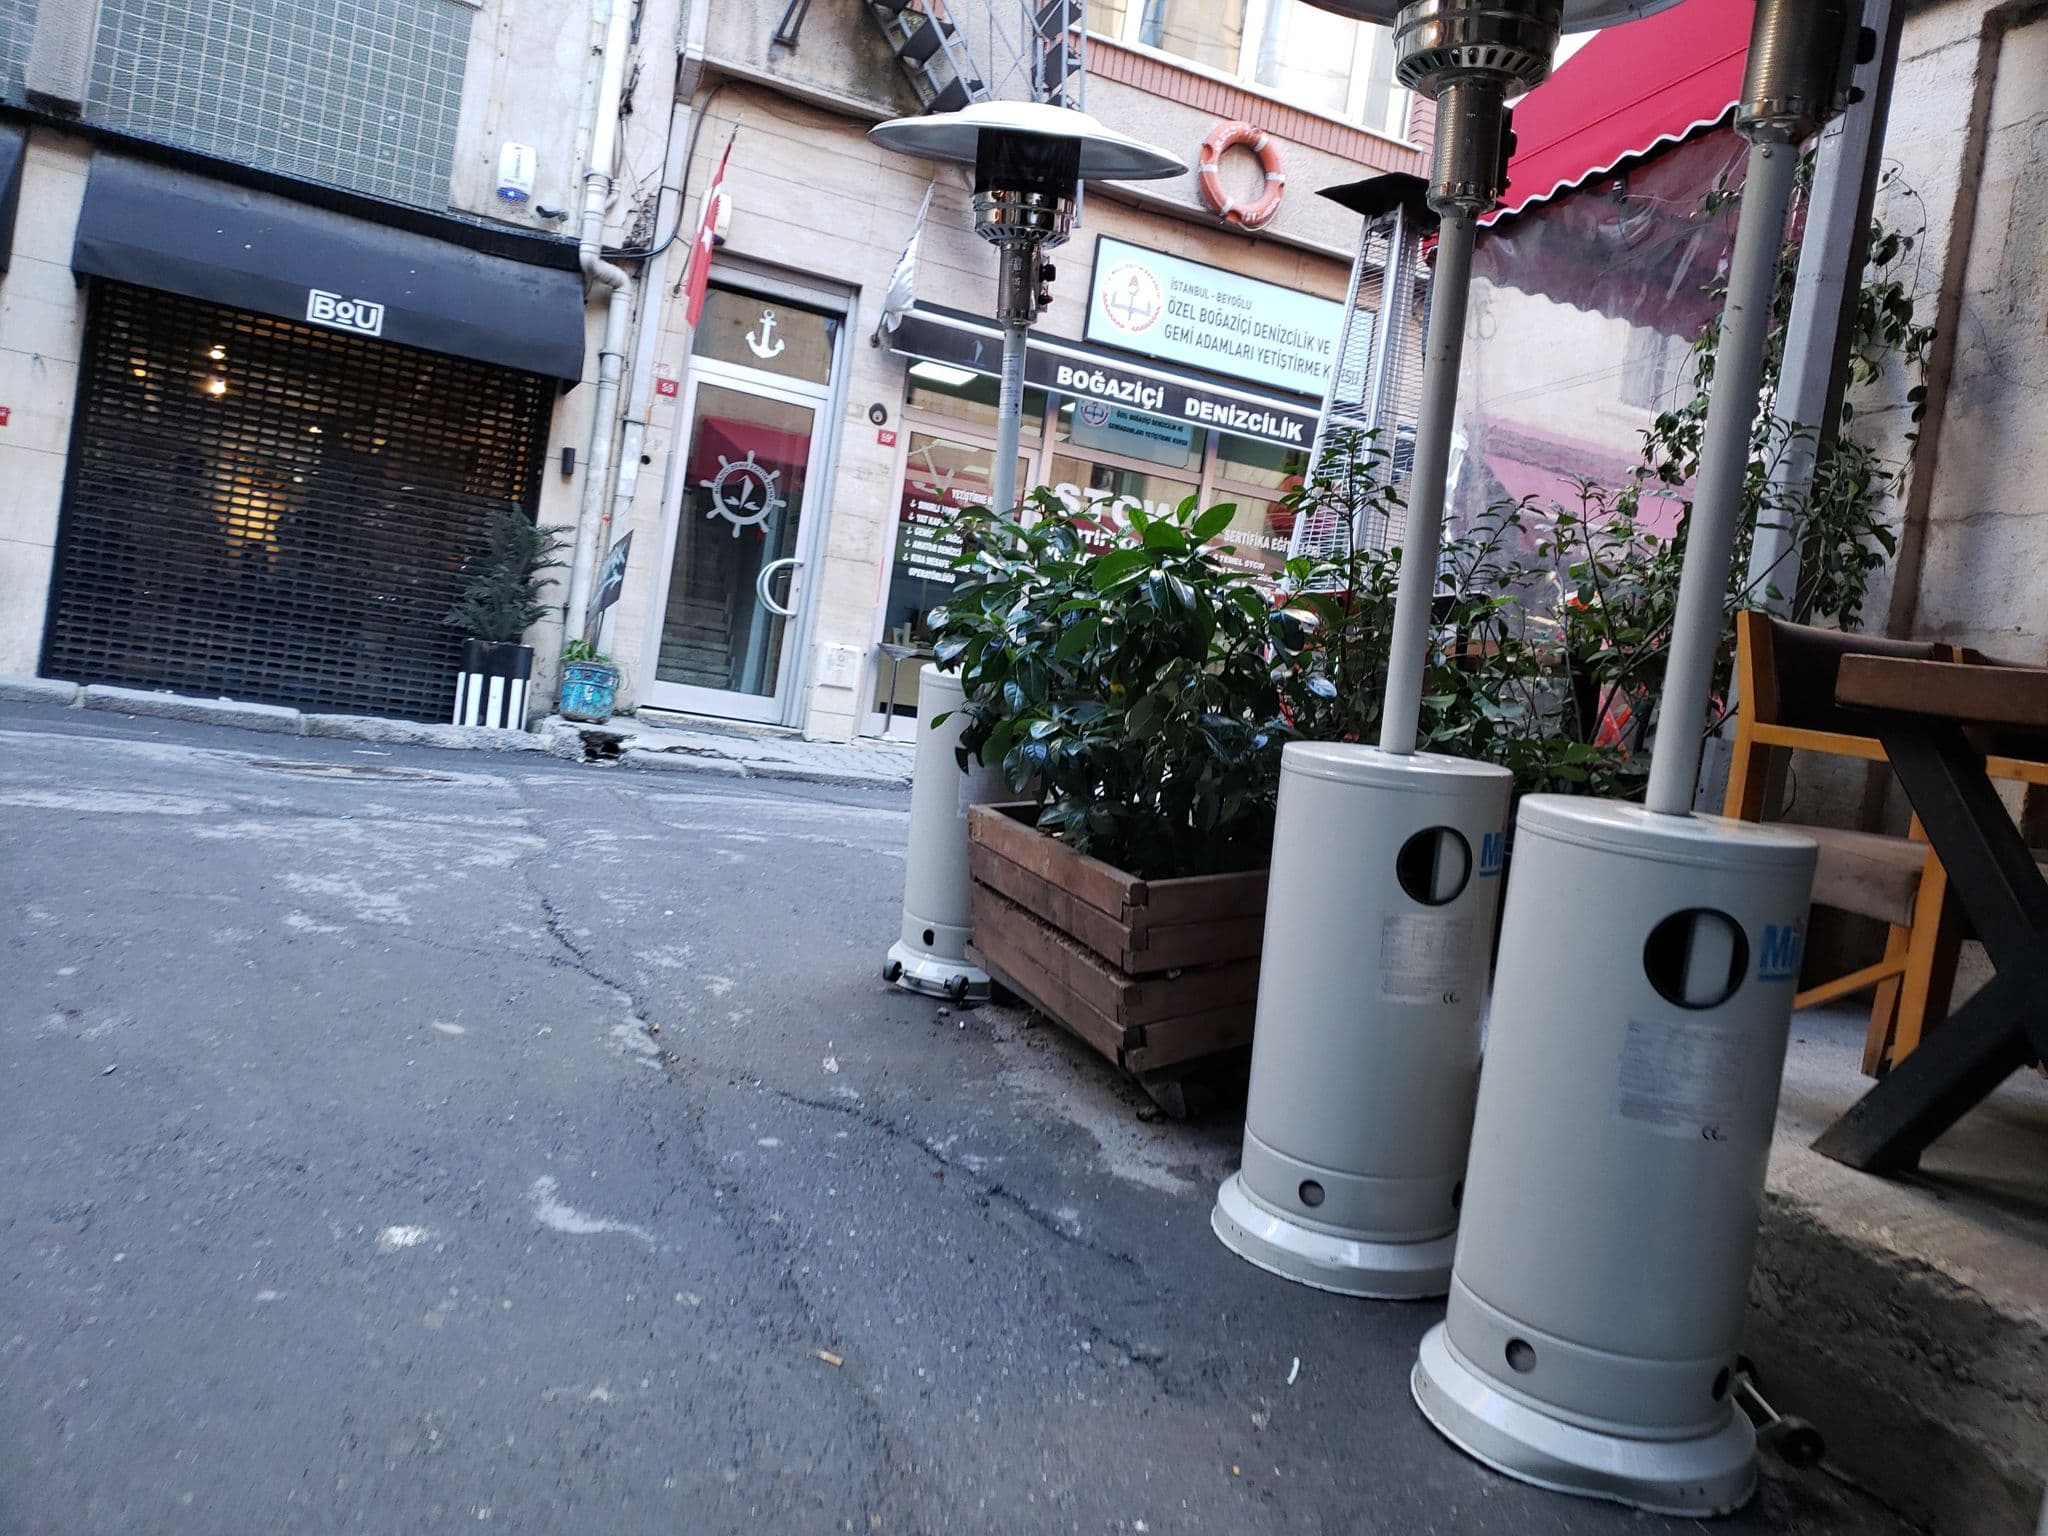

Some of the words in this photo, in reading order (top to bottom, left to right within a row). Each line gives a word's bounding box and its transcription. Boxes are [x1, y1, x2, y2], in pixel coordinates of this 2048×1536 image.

[1170, 277, 1210, 300] İSTANBUL
[1217, 292, 1252, 310] BEYOĞLU
[1164, 324, 1194, 345] GEMİ
[1195, 332, 1254, 360] ADAMLARI
[1257, 348, 1321, 376] YETİŞTİRME
[1168, 295, 1196, 320] ÖZEL
[1200, 307, 1251, 335] BOĞAZİÇİ
[1253, 322, 1315, 350] DENİZCİLİK
[1318, 338, 1331, 354] VE
[1057, 365, 1165, 410] BOĞAZİÇİ
[1185, 397, 1303, 442] DENİZCİLİK
[1223, 527, 1270, 550] SERTİFİKA
